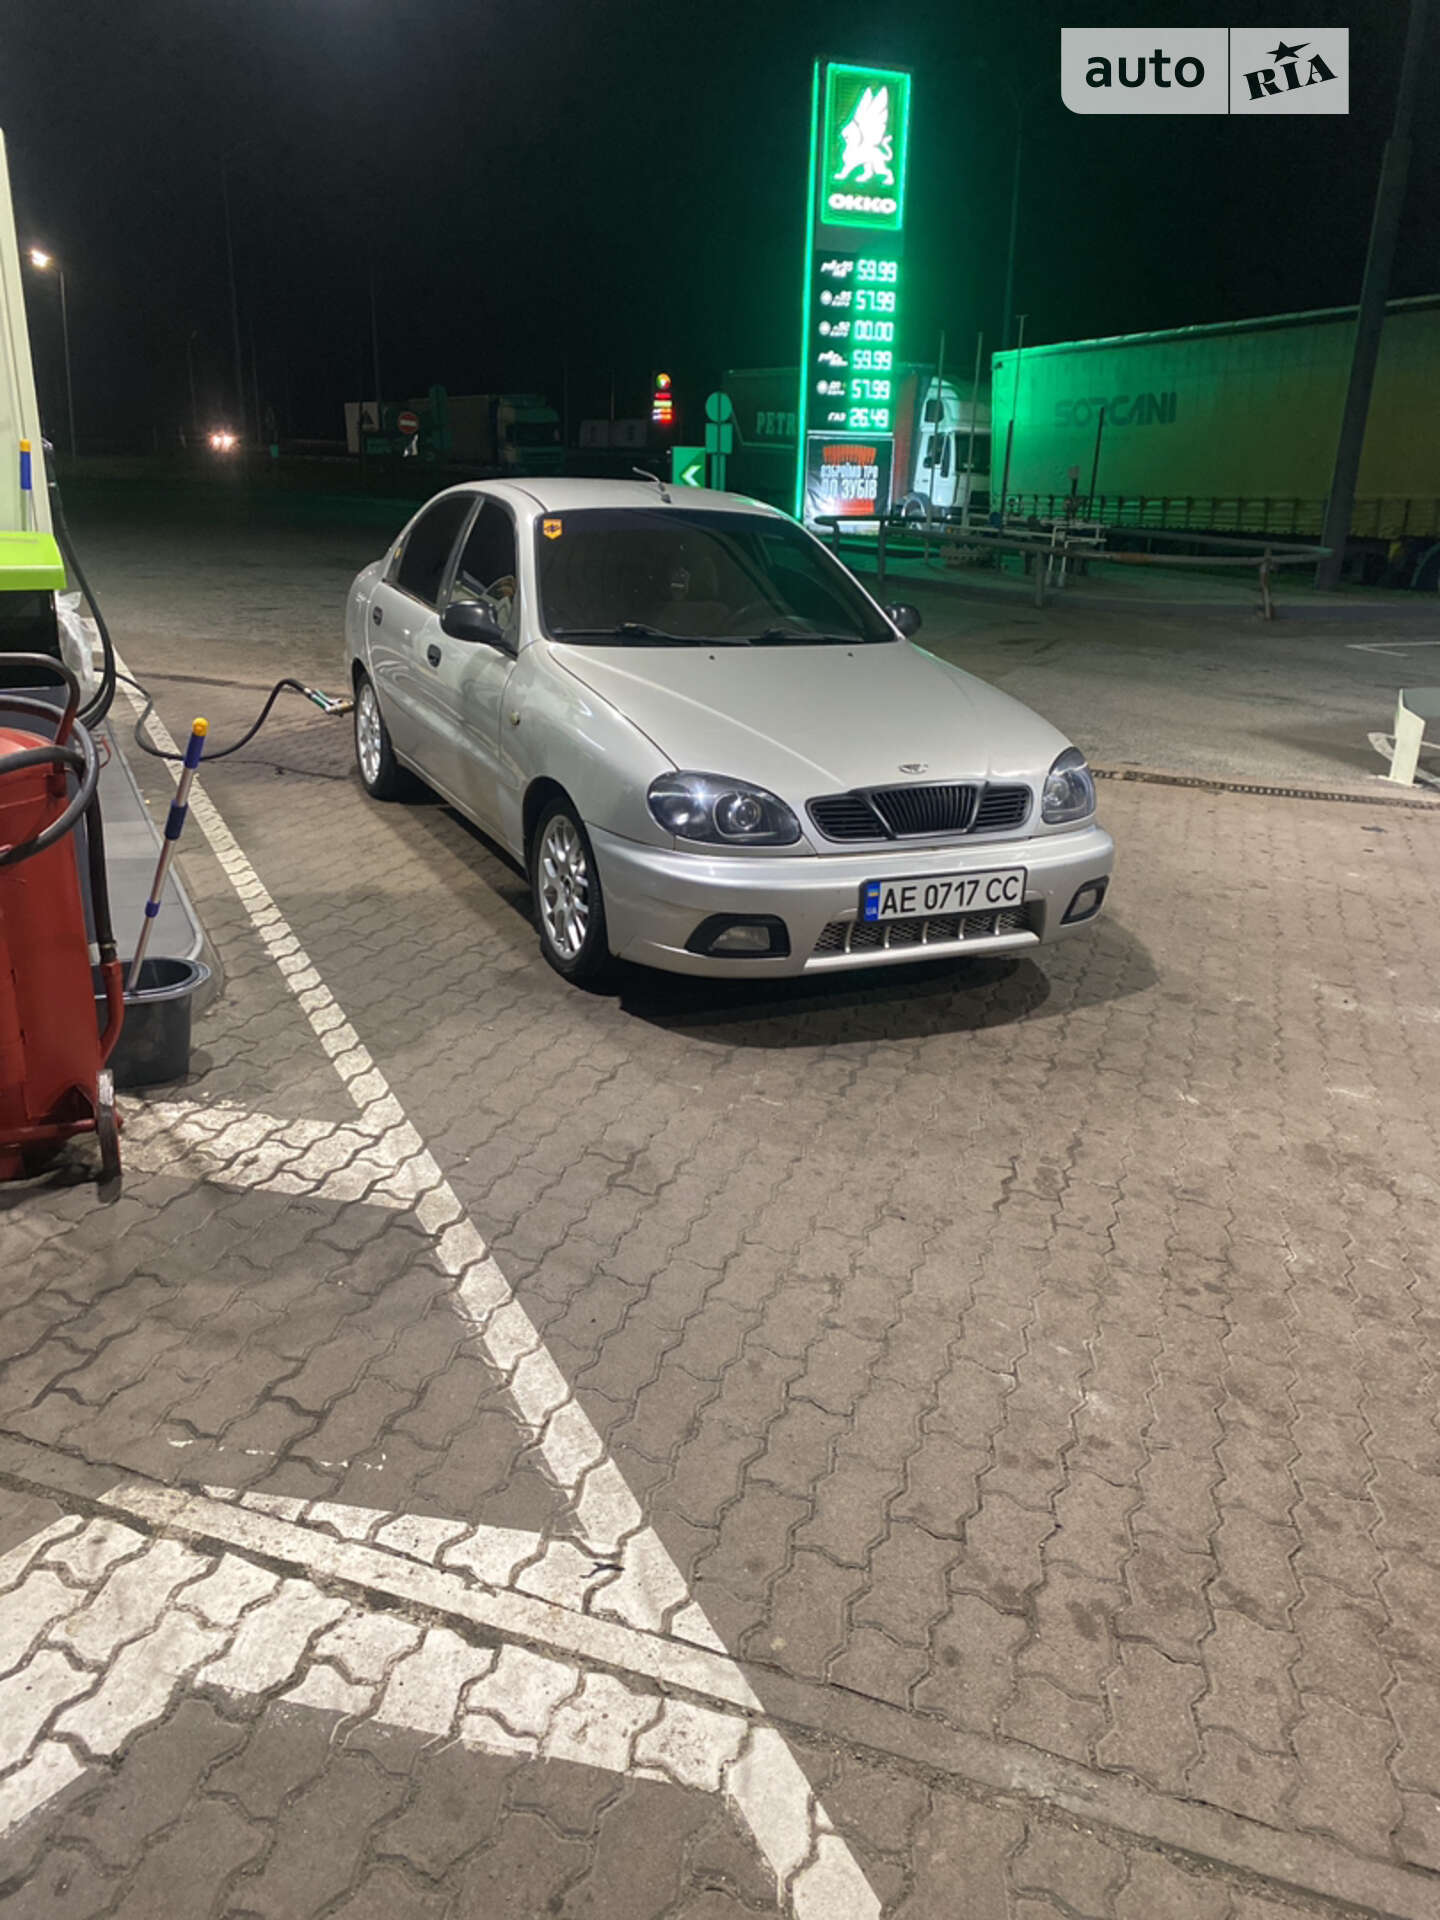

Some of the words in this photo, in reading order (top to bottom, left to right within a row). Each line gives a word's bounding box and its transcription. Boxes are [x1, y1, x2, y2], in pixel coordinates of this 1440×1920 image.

[828, 193, 897, 214] OKKO
[856, 259, 897, 283] 59.99
[855, 289, 895, 312] 57.99
[854, 319, 894, 342] 00.00
[852, 349, 892, 371] 59.99
[851, 378, 890, 400] 57.99
[850, 407, 889, 428] 26.49
[881, 887, 917, 914] AE
[924, 880, 979, 910] 0717
[986, 876, 1019, 903] CC
